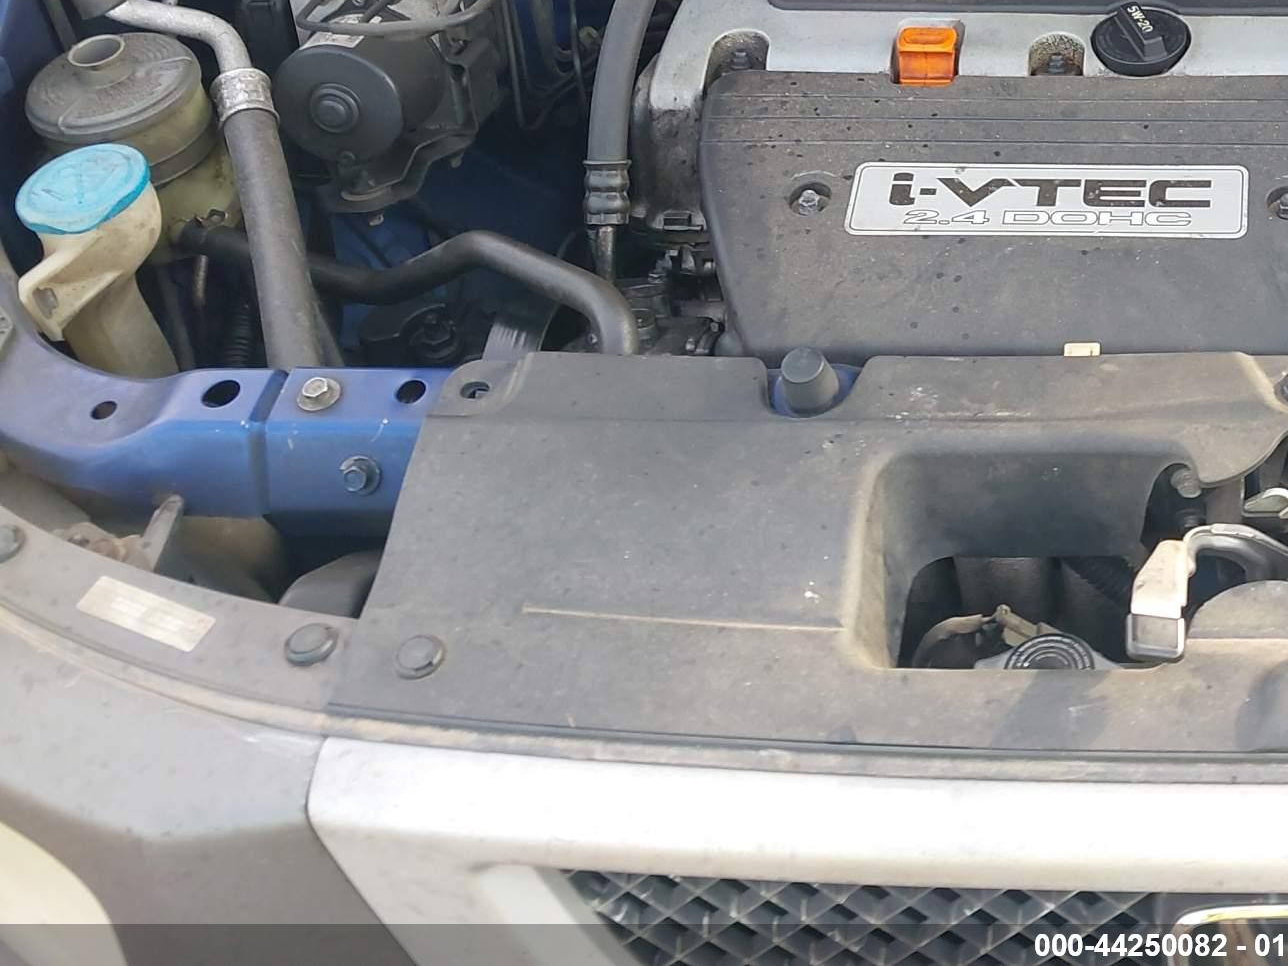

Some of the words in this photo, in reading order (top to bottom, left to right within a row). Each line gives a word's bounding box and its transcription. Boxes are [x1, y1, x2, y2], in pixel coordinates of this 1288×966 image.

[1126, 5, 1154, 34] 5W-20
[888, 172, 1212, 208] i-VTEC
[904, 209, 991, 226] 2.4
[1001, 209, 1193, 227] DOHC
